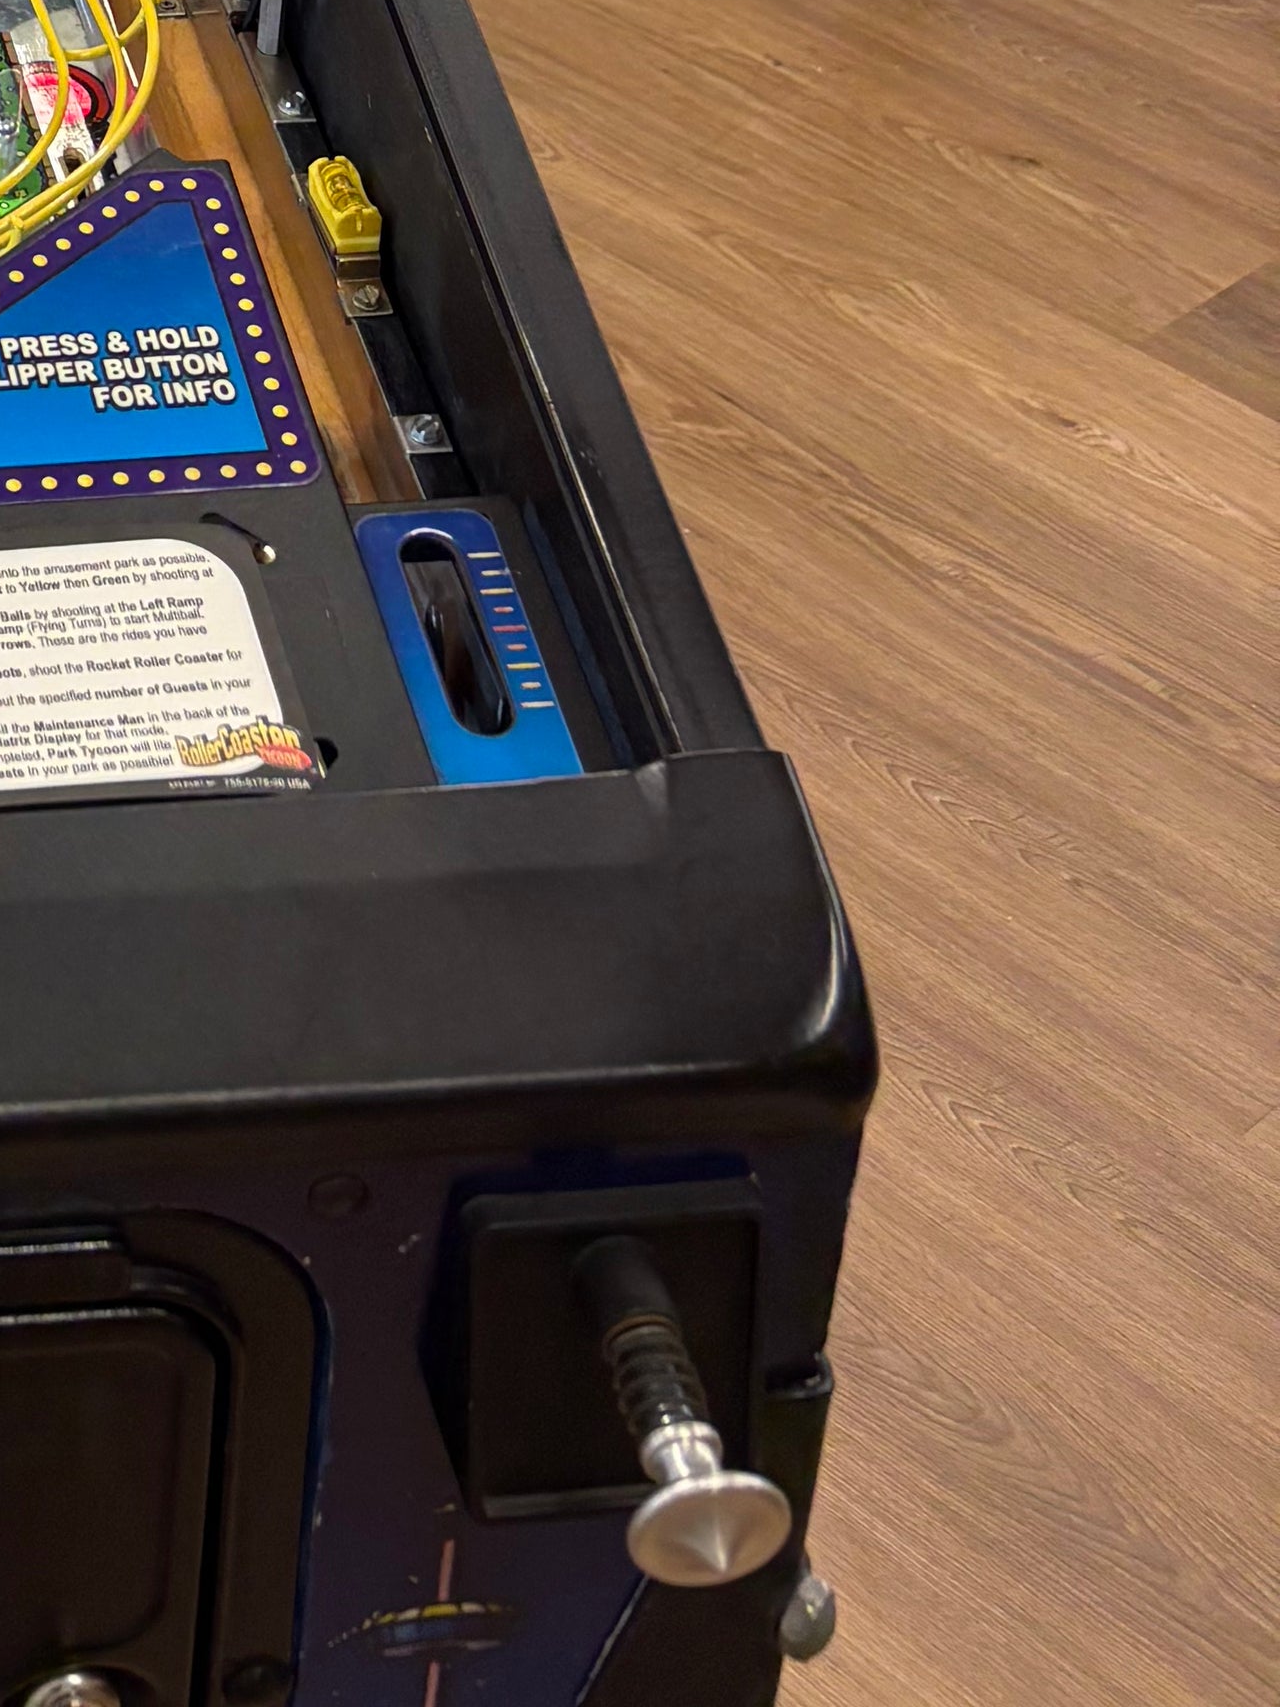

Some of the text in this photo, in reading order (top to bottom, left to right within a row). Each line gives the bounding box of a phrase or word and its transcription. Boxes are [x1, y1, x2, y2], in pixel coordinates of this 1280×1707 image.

[0, 325, 220, 360] PRESS & HOLD
[102, 351, 229, 381] BUTTON
[92, 378, 236, 410] FOR INFO
[22, 566, 39, 577] the
[45, 559, 110, 575] amusement
[115, 557, 139, 570] park
[143, 557, 156, 567] as
[159, 549, 210, 567] possible.
[176, 717, 301, 766] RollerCoaster
